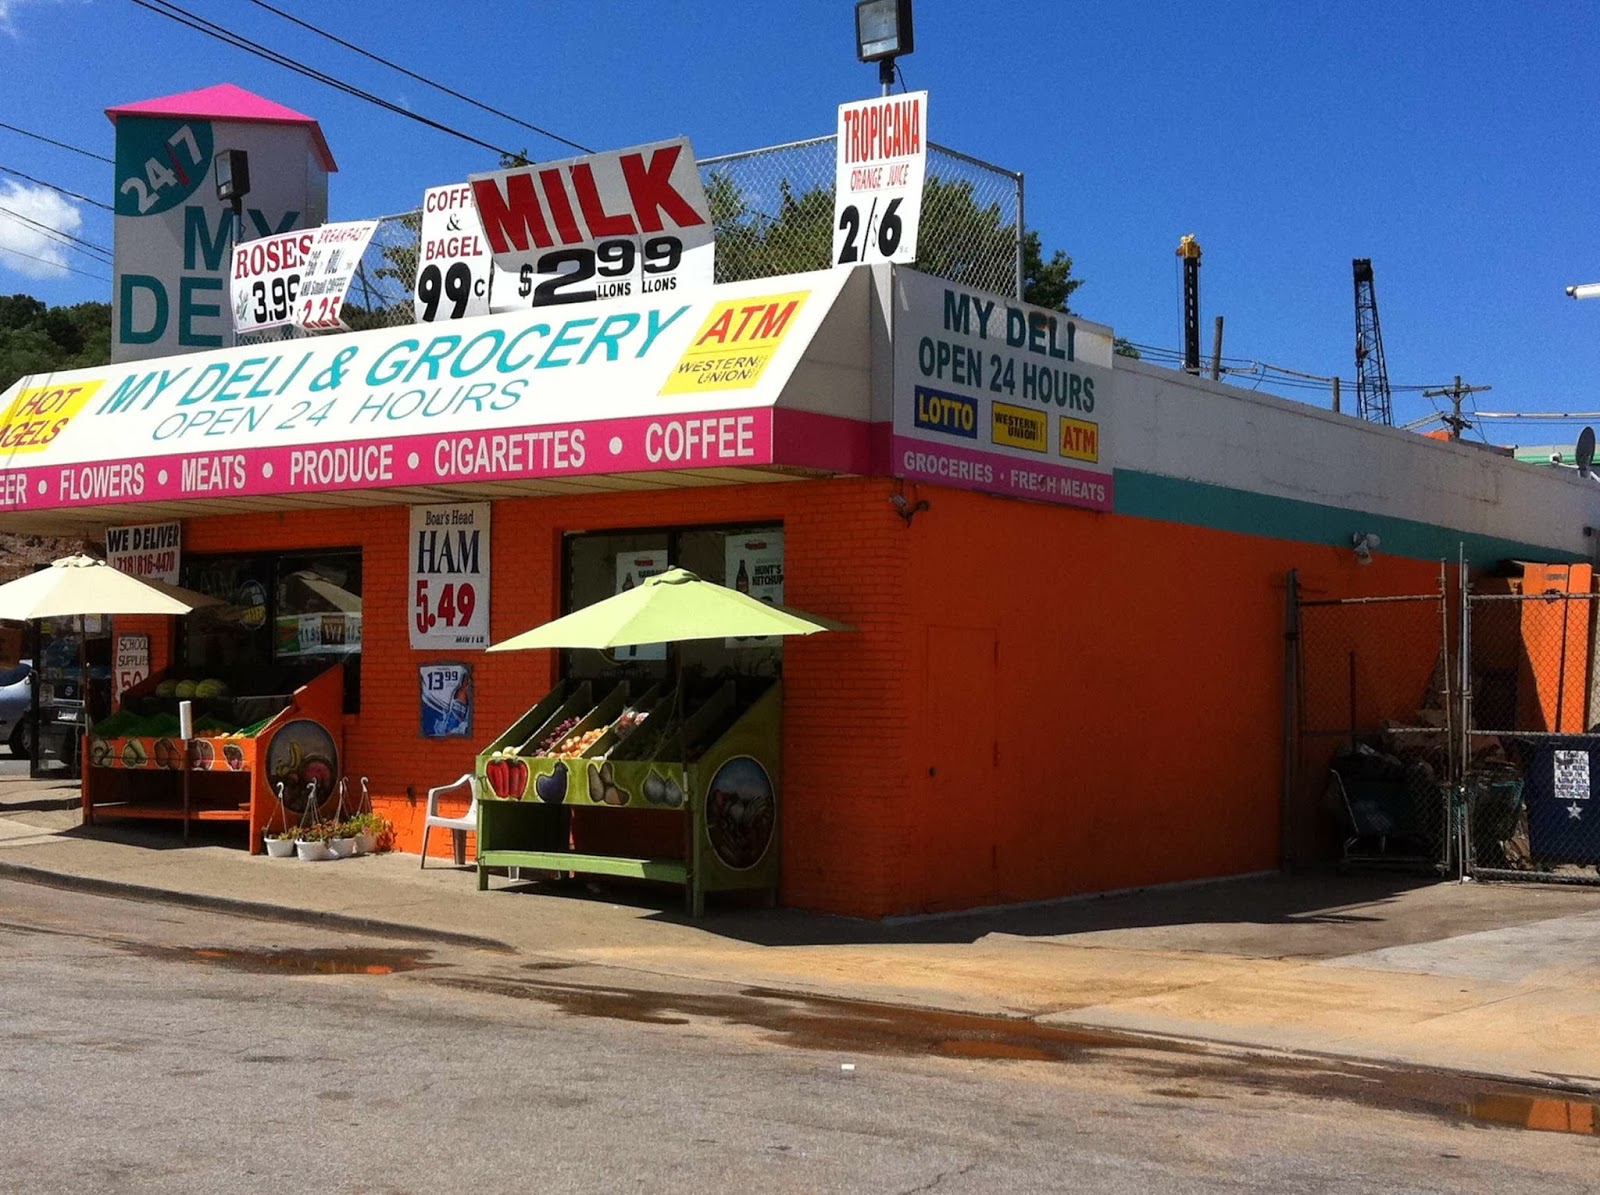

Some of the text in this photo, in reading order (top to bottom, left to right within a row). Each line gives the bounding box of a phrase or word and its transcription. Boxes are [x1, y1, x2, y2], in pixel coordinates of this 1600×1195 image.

[844, 99, 920, 164] TROPICANA
[120, 125, 203, 213] 24/7
[850, 164, 910, 191] ORANGE JUICE
[427, 188, 472, 214] COFF
[472, 145, 705, 254] MILK
[446, 213, 462, 231] &
[235, 234, 314, 280] ROSES
[425, 236, 483, 260] BAGEL
[696, 300, 799, 347] ATM
[944, 289, 1076, 362] MY DELI
[95, 305, 692, 415] MY DELI & GROCERY
[678, 355, 760, 373] WESTERN
[697, 369, 752, 384] UNION
[918, 336, 1095, 413] OPEN 24 HOURS
[16, 387, 83, 417] HOT
[151, 379, 529, 441] OPEN 24 HOURS
[918, 393, 974, 431] LOTTO
[994, 412, 1036, 430] WESTERN
[1008, 426, 1036, 441] UNION
[1063, 425, 1095, 455] ATM
[60, 462, 145, 502] FLOWERS
[181, 454, 246, 492] MEATS
[290, 444, 393, 485] PRODUCE
[434, 428, 586, 477] CIGARETTES
[645, 416, 754, 463] COFFEE
[904, 451, 1105, 502] GROCERIES FRESH MEATS
[426, 510, 474, 526] Boar's Head
[108, 524, 179, 552] WE DELIVER
[417, 530, 480, 574] HAM
[416, 579, 475, 634] 5.49
[119, 638, 148, 652] SCHOOL
